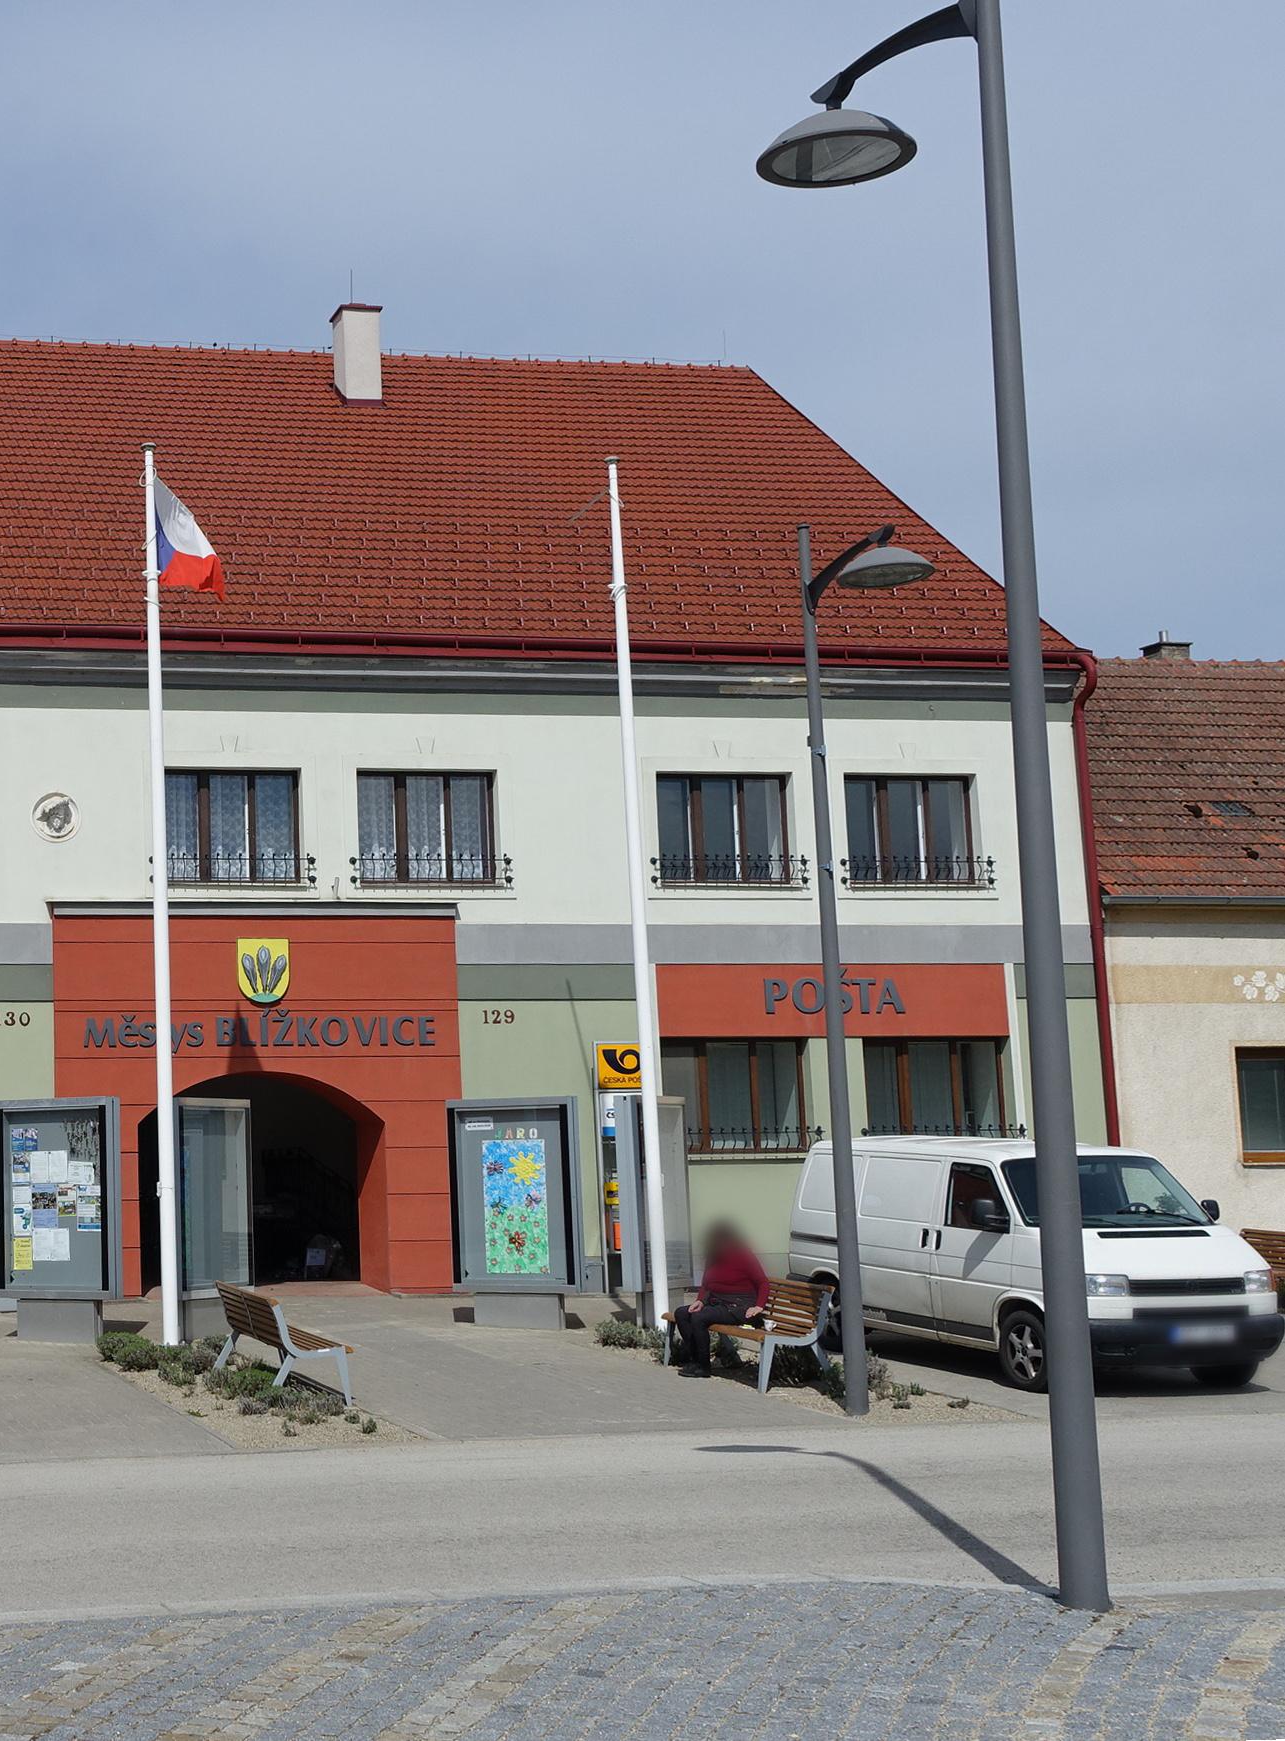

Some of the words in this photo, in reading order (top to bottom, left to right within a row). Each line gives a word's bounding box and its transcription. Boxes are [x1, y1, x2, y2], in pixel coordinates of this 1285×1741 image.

[482, 1009, 515, 1025] 129
[83, 1014, 205, 1055] Měsys
[216, 1008, 437, 1048] BLÍŽKOVICE
[495, 1127, 538, 1139] JARO
